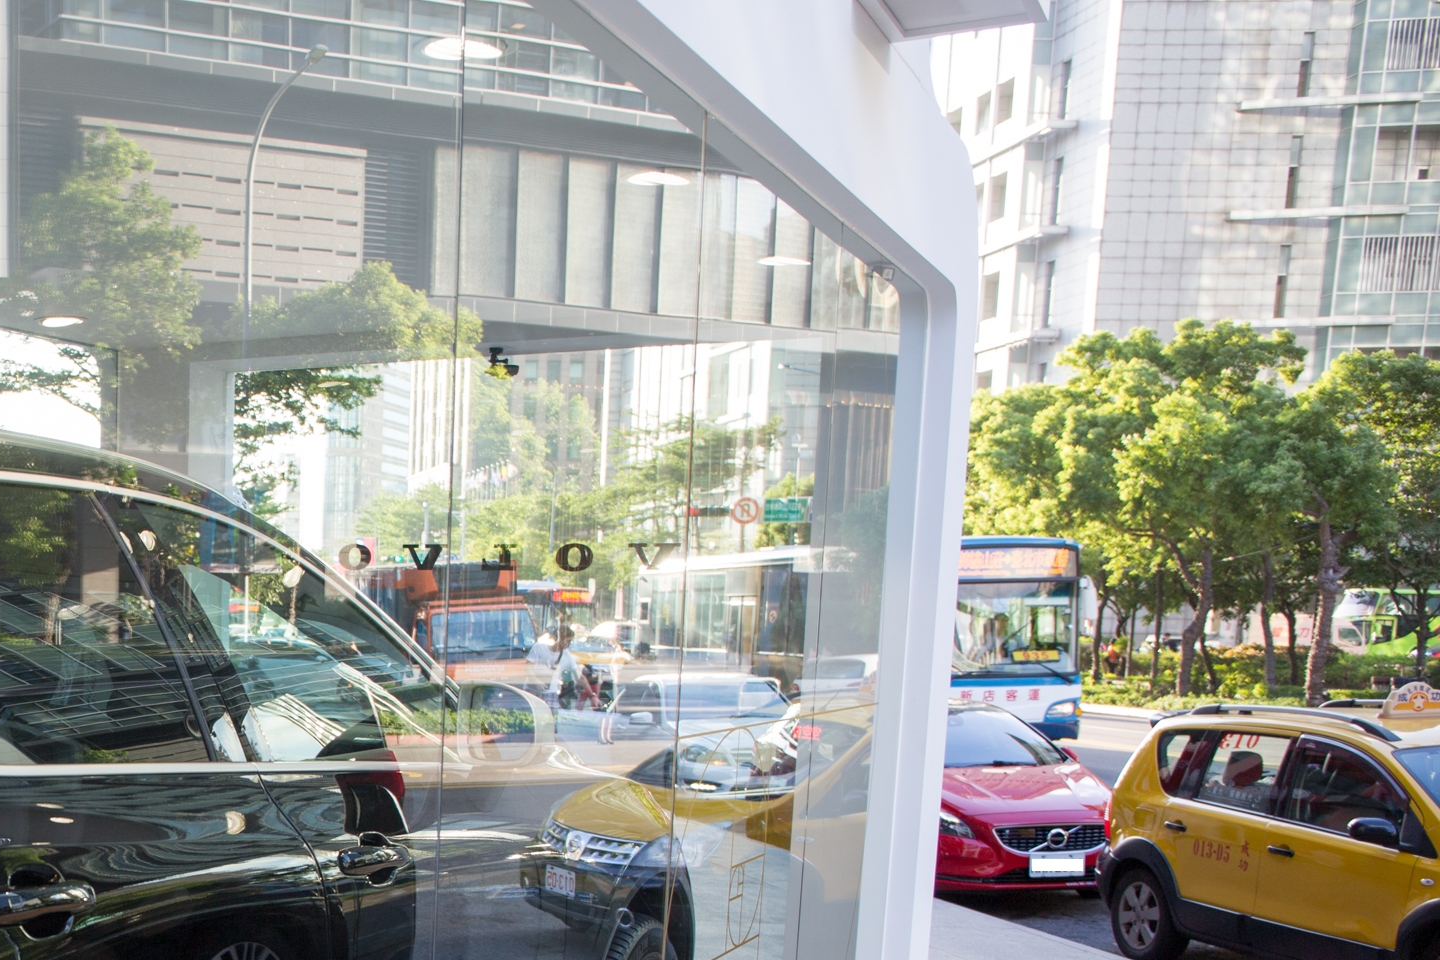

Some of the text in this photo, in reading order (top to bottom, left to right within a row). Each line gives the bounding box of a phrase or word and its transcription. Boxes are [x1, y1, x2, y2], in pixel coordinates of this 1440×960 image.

[1022, 650, 1050, 661] 935
[959, 688, 1041, 702] 新店客運
